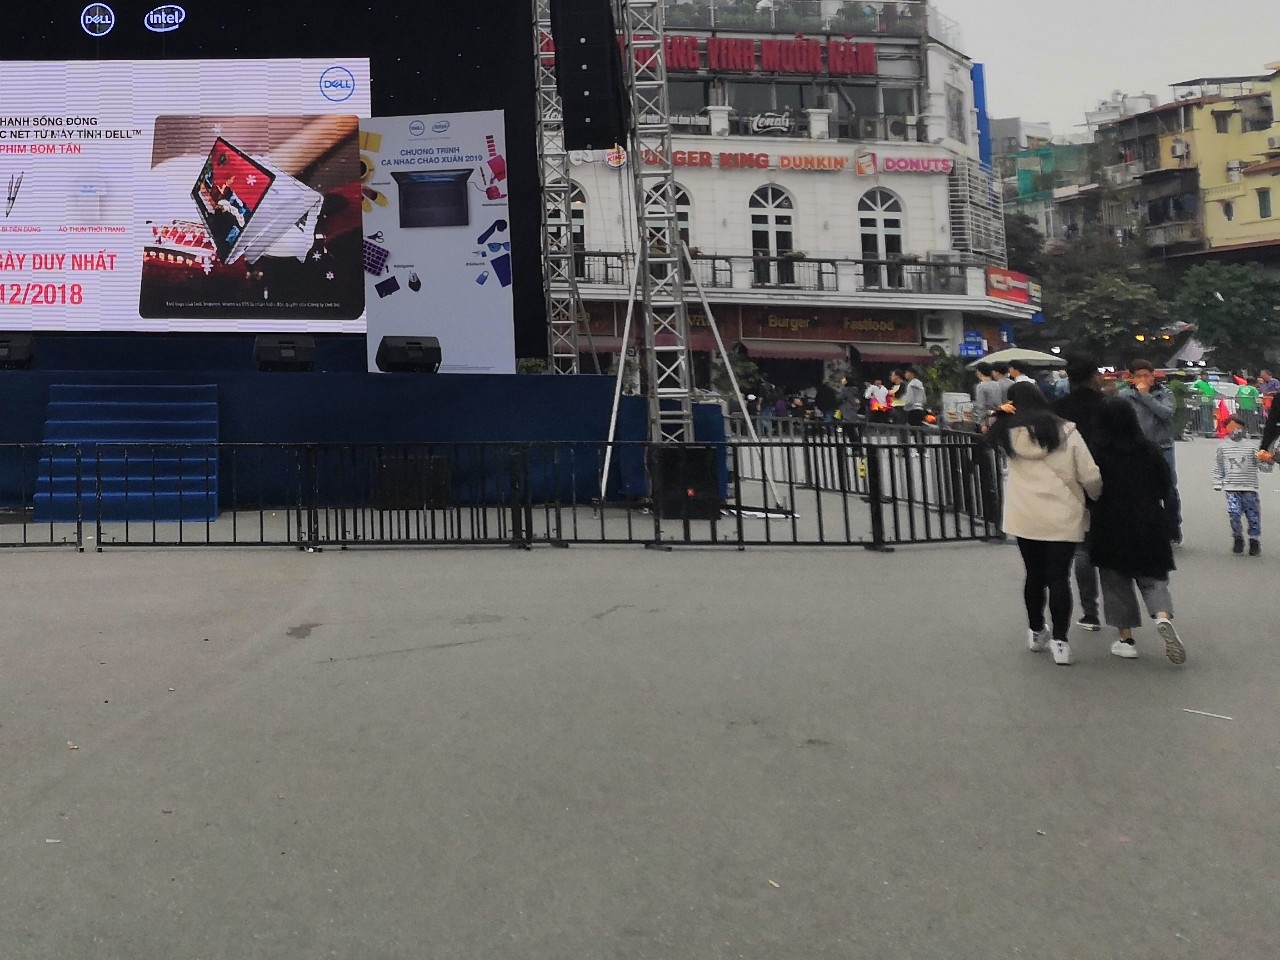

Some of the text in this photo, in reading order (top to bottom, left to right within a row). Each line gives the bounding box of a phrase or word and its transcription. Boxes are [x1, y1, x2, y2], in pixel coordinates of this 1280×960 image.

[85, 14, 112, 24] DELL
[149, 10, 179, 24] intel
[324, 79, 352, 89] DELL
[30, 144, 56, 154] BOM
[719, 152, 770, 169] KING
[884, 157, 953, 172] DONUTS
[32, 253, 67, 271] DUY
[71, 249, 117, 271] NHẤT
[767, 314, 809, 332] Burger
